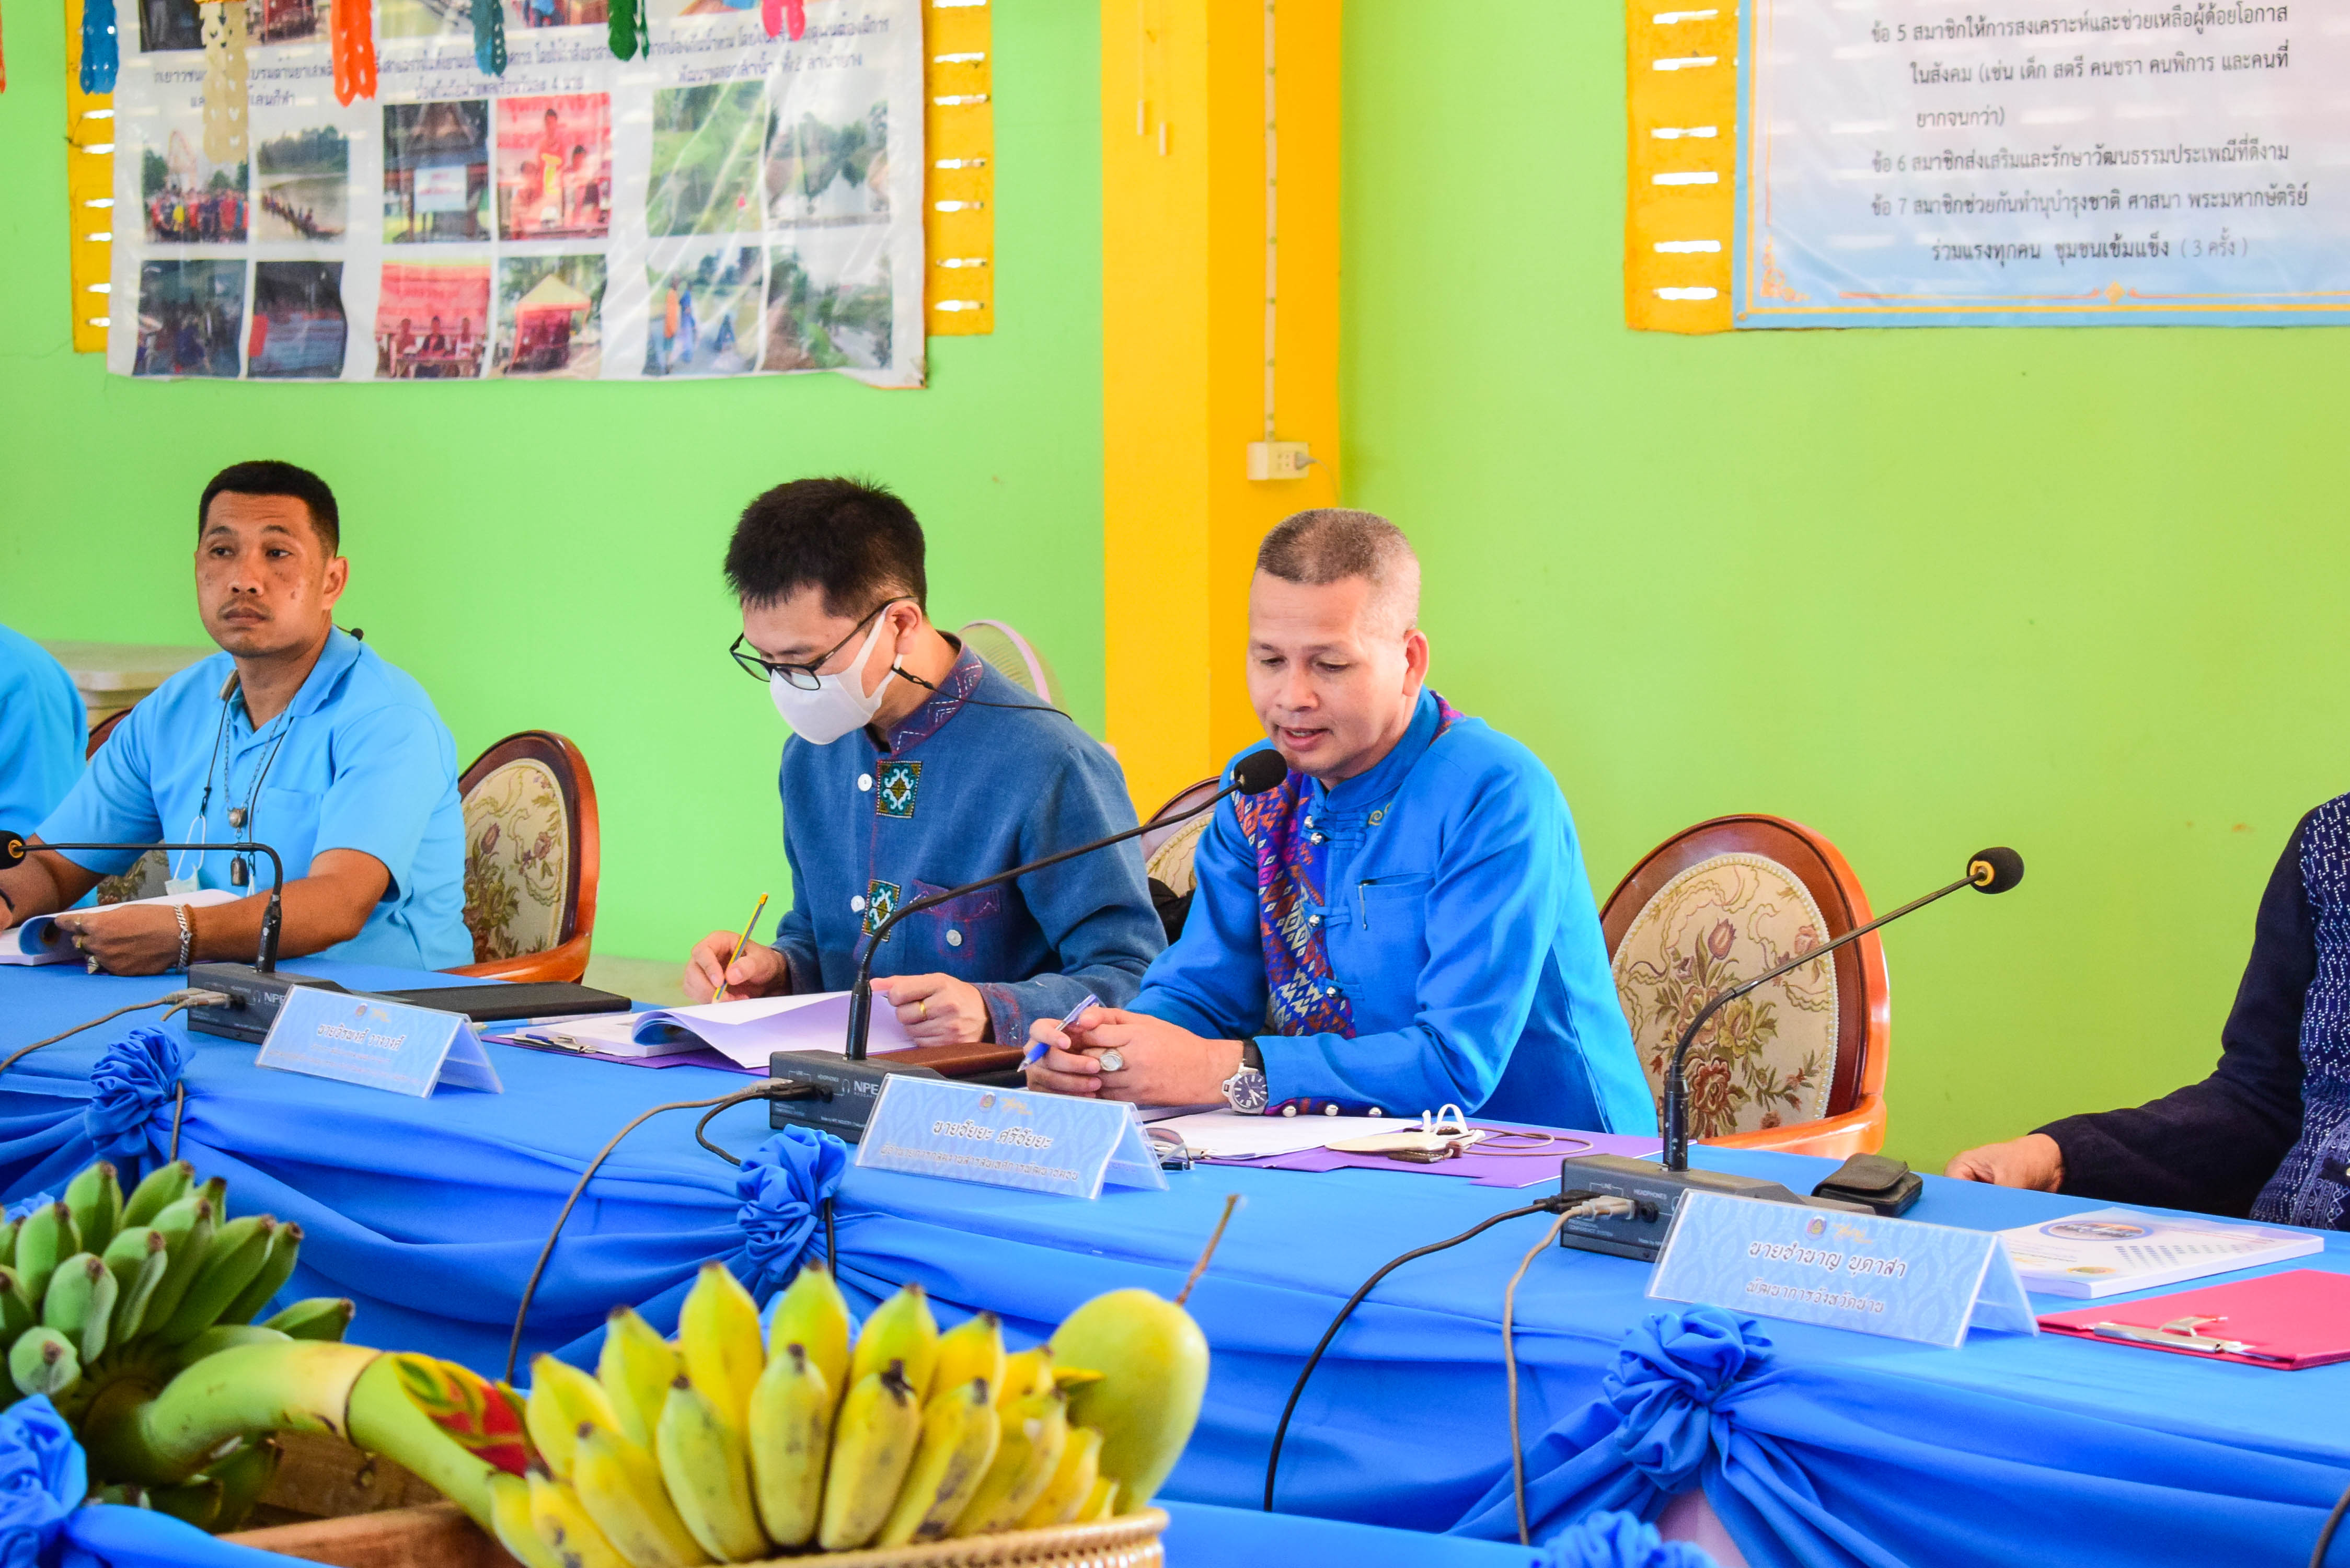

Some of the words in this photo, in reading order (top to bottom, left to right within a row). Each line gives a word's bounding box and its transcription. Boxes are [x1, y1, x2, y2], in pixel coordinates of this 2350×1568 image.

[1871, 19, 1890, 43] ข้อ
[1897, 24, 1906, 42] 5
[1909, 61, 1972, 84] ในสังคม
[2020, 55, 2047, 80] เด็ก
[2053, 54, 2084, 78] สตรี
[2090, 59, 2142, 77] คนชรา
[2150, 51, 2215, 74] คนพิการ
[2221, 39, 2289, 71] และคนที่
[1917, 105, 2006, 128] ยากจนกว่า)
[1871, 149, 1892, 172] ข้อ
[1898, 154, 1906, 171] 6
[1871, 193, 1891, 216] ข้อ
[1898, 198, 1907, 214] 7
[2128, 192, 2181, 209] ศาสนา
[2188, 182, 2309, 207] พระมหากษัตริย์
[1933, 238, 2041, 268] ร่วมแรงทุกคน
[2055, 230, 2169, 267] ชุมชนเข้มแข็ง
[2193, 240, 2202, 257] 3
[2208, 226, 2236, 257] ครั้ง
[854, 1080, 879, 1095] NPE
[1749, 1242, 1842, 1271] นายชำนาญ
